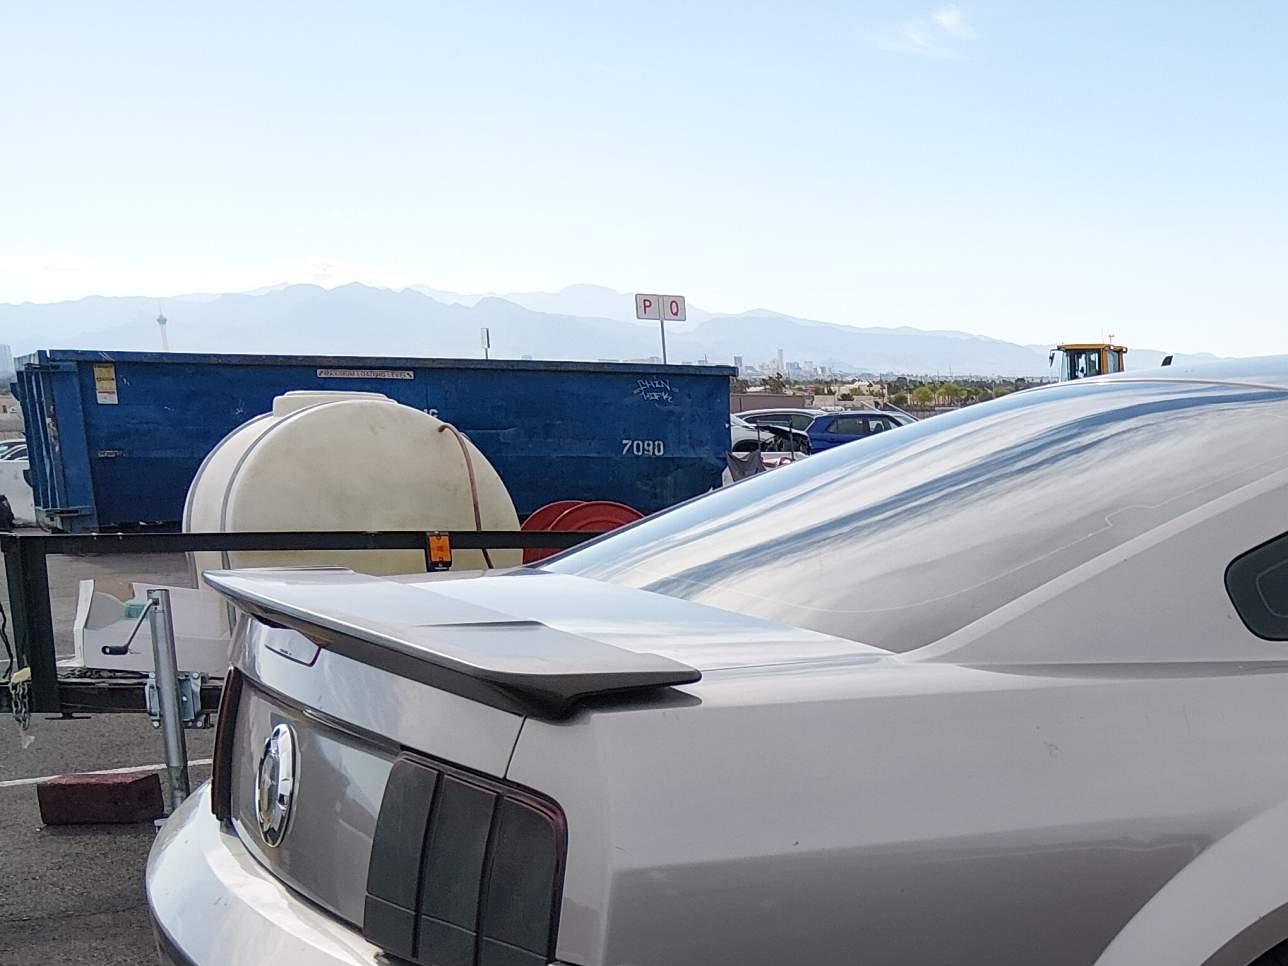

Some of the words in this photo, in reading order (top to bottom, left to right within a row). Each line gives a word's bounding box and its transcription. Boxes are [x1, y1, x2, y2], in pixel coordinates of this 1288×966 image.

[642, 299, 652, 315] P
[669, 300, 680, 317] Q
[622, 440, 664, 457] 7090
